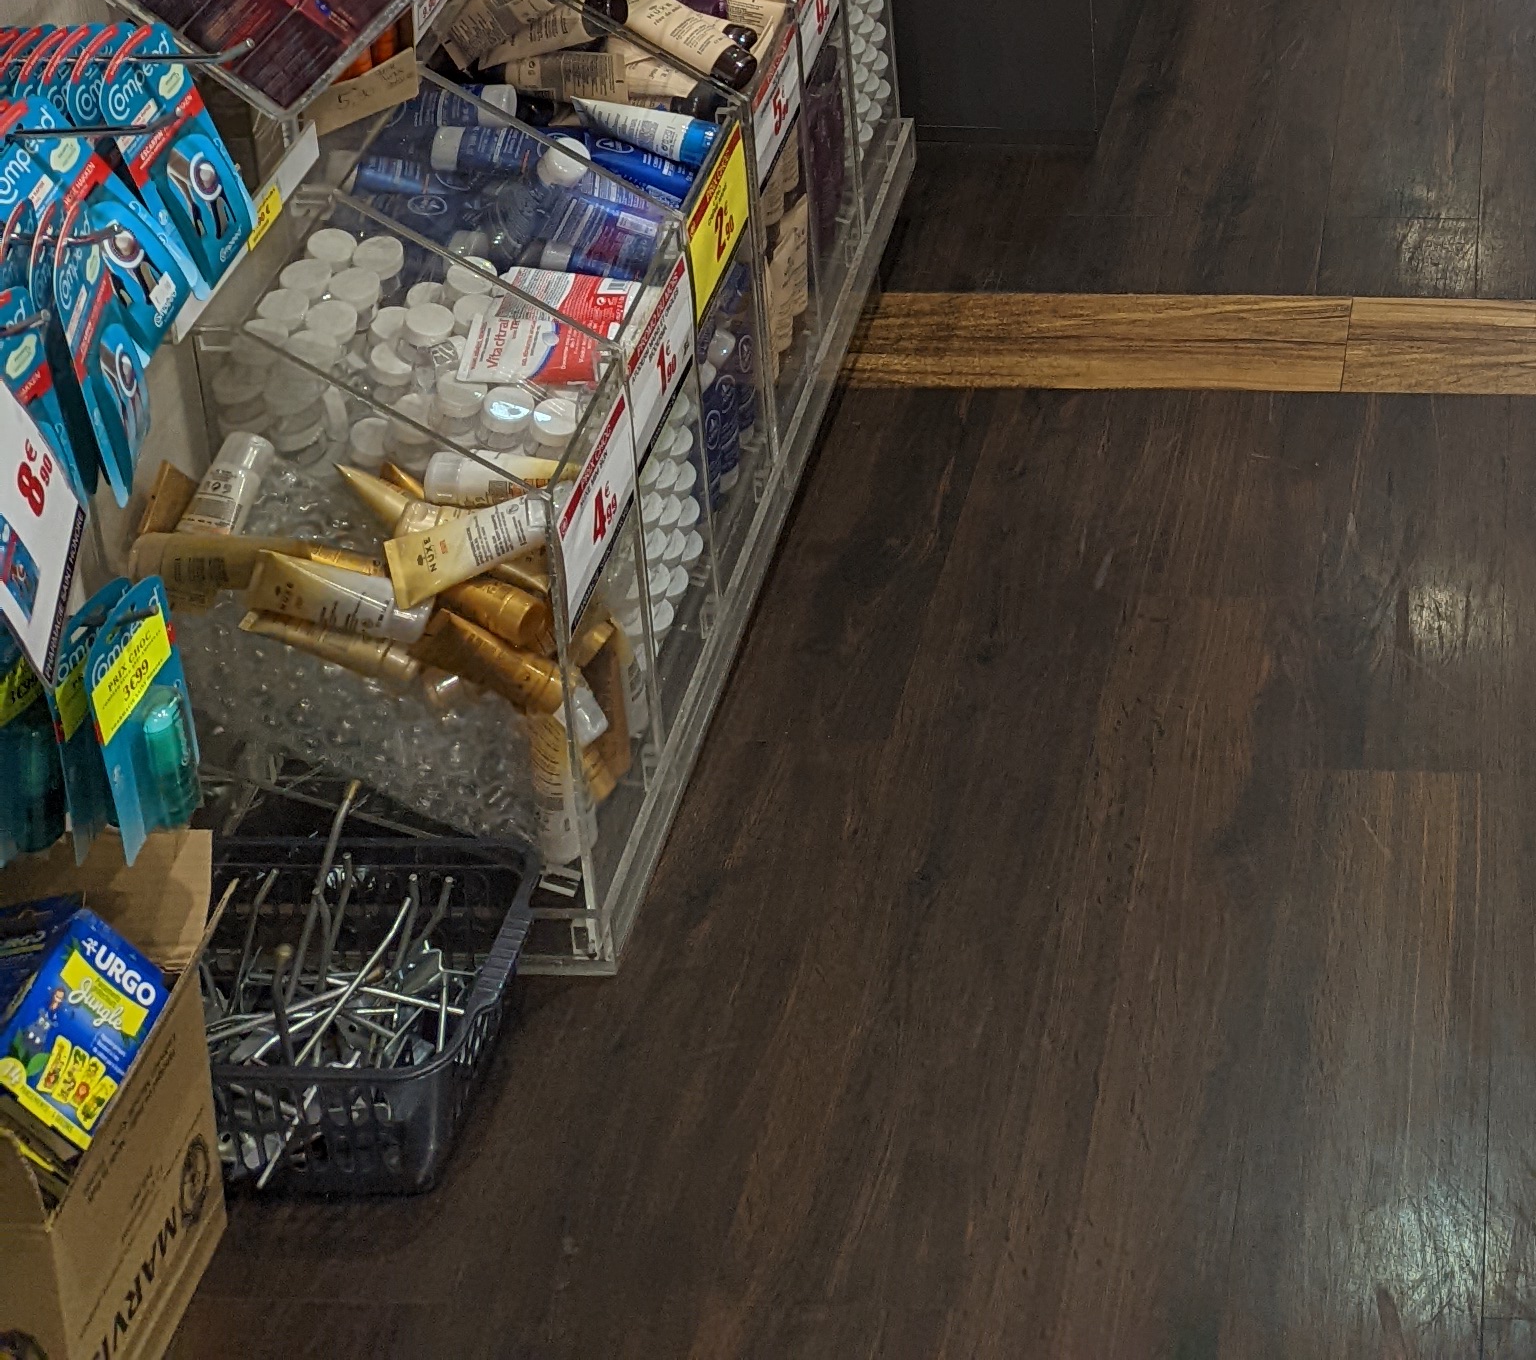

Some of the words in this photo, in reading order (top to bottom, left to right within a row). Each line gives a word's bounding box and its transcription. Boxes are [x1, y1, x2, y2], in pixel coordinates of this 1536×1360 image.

[423, 536, 438, 573] NUXE
[107, 661, 129, 692] PRIX
[128, 628, 153, 666] CHOC
[68, 978, 125, 1031] Jungle
[94, 946, 157, 1007] URGO
